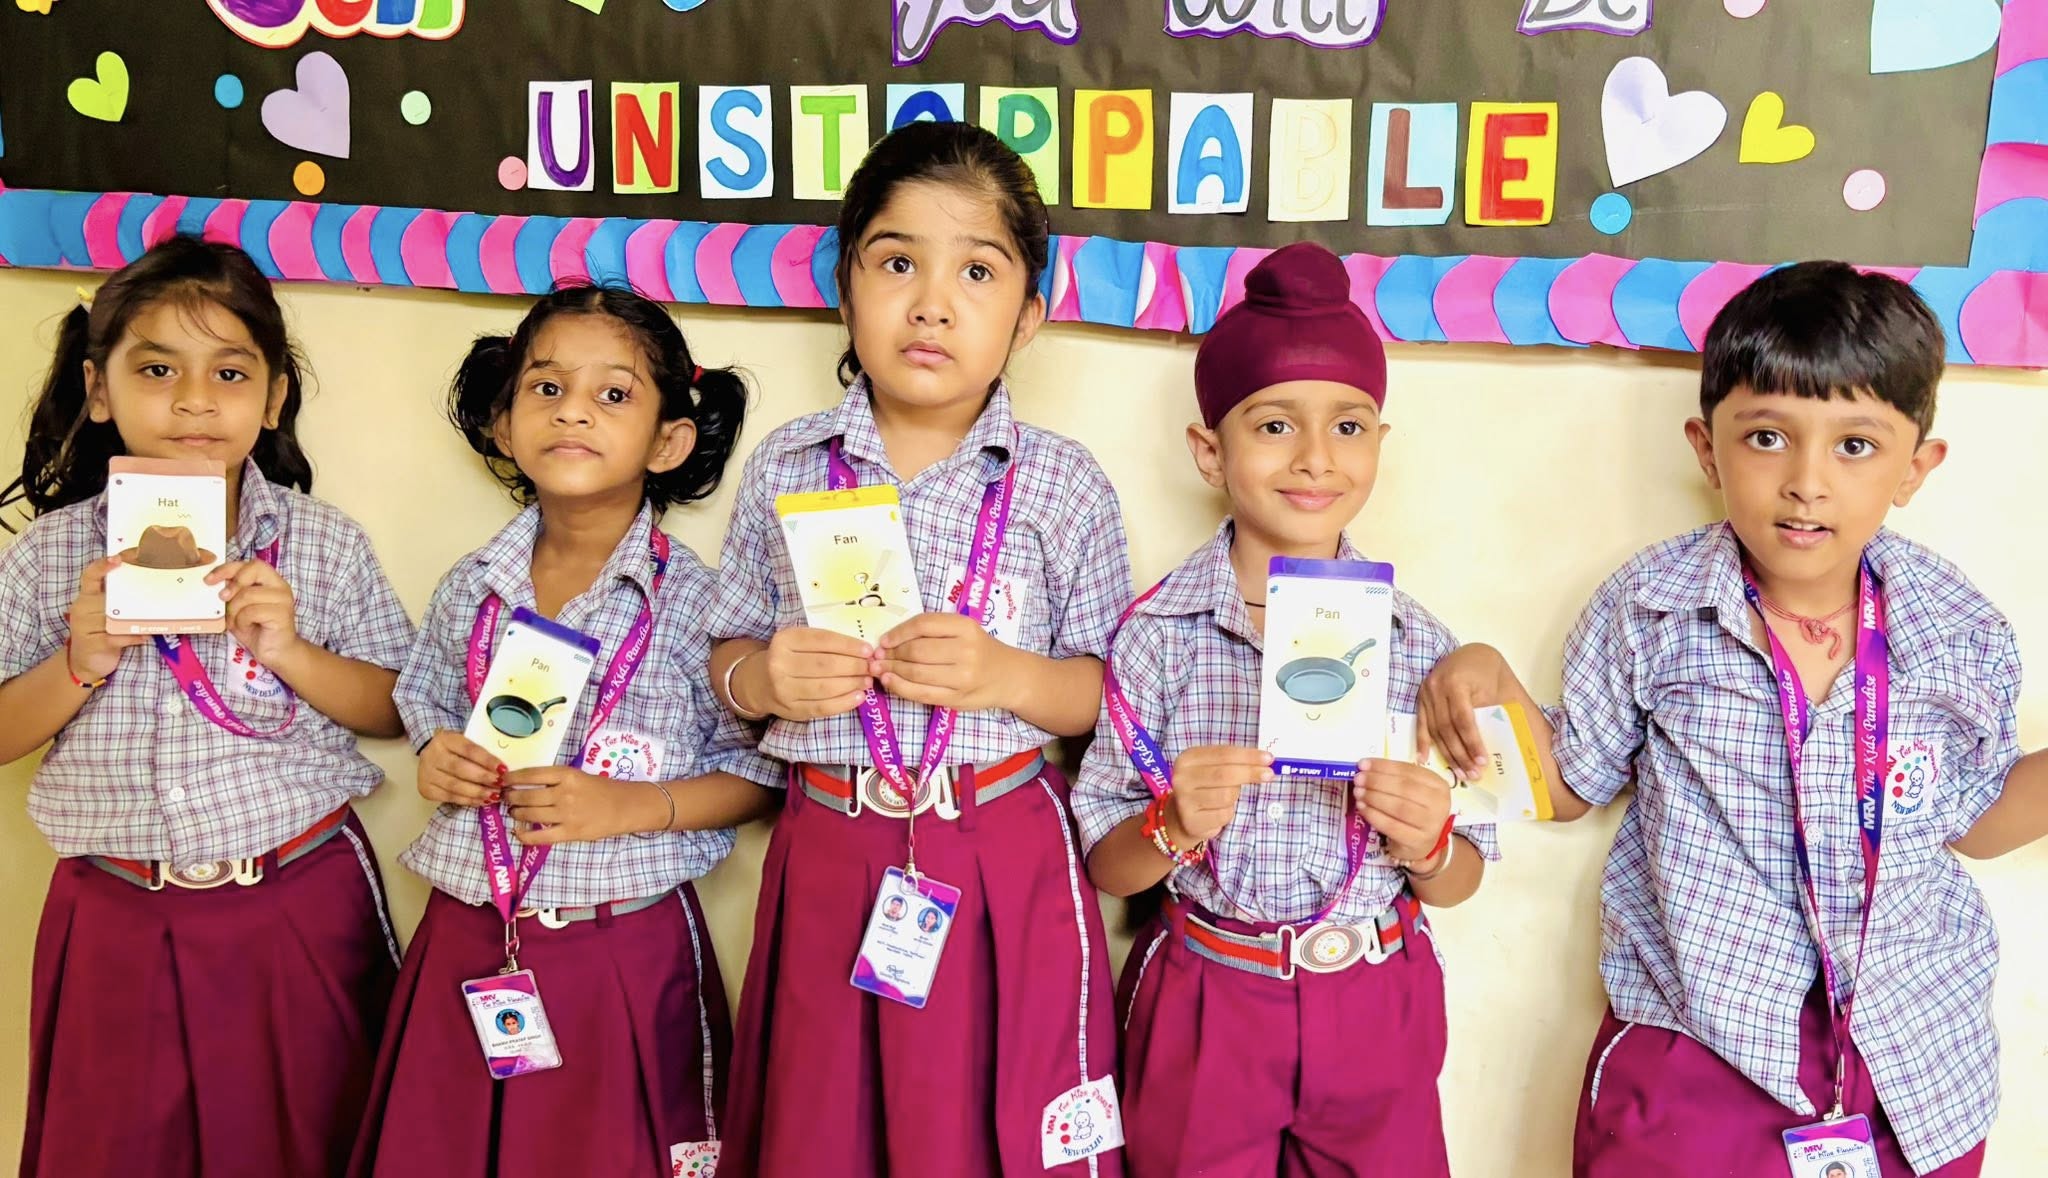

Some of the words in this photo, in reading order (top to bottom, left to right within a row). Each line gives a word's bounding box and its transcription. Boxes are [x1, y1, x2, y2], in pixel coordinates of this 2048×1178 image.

[537, 89, 1548, 221] UNSTPPABLE
[158, 498, 179, 507] Hat
[989, 474, 1007, 519] Paradis
[834, 535, 858, 544] Fan
[982, 520, 998, 551] Kids
[976, 549, 990, 574] The
[948, 580, 964, 603] MRV
[967, 576, 985, 608] MRV
[1315, 607, 1340, 619] Pan
[1863, 595, 1876, 630] MRV
[477, 605, 495, 651] Paradise
[531, 657, 550, 672] Pan
[600, 687, 615, 709] The
[611, 662, 630, 685] Kids
[626, 619, 651, 663] Paradis
[1861, 674, 1877, 731] Paradise
[867, 707, 887, 738] Kids
[928, 738, 942, 762] The
[935, 706, 951, 736] Kids
[585, 742, 601, 765] MRV
[877, 738, 894, 762] The
[1132, 739, 1156, 767] Kids
[1861, 735, 1878, 766] Kids
[1493, 752, 1505, 775] Fan
[885, 763, 908, 791] MRV
[1151, 766, 1168, 788] The
[1862, 769, 1875, 794] The
[1862, 796, 1875, 830] MRV
[483, 815, 498, 842] Kids
[489, 843, 504, 864] The
[525, 846, 539, 866] The
[493, 865, 512, 895] MRV
[480, 994, 496, 1002] MRV
[1062, 1146, 1080, 1156] NEW
[1804, 1144, 1823, 1153] MRV
